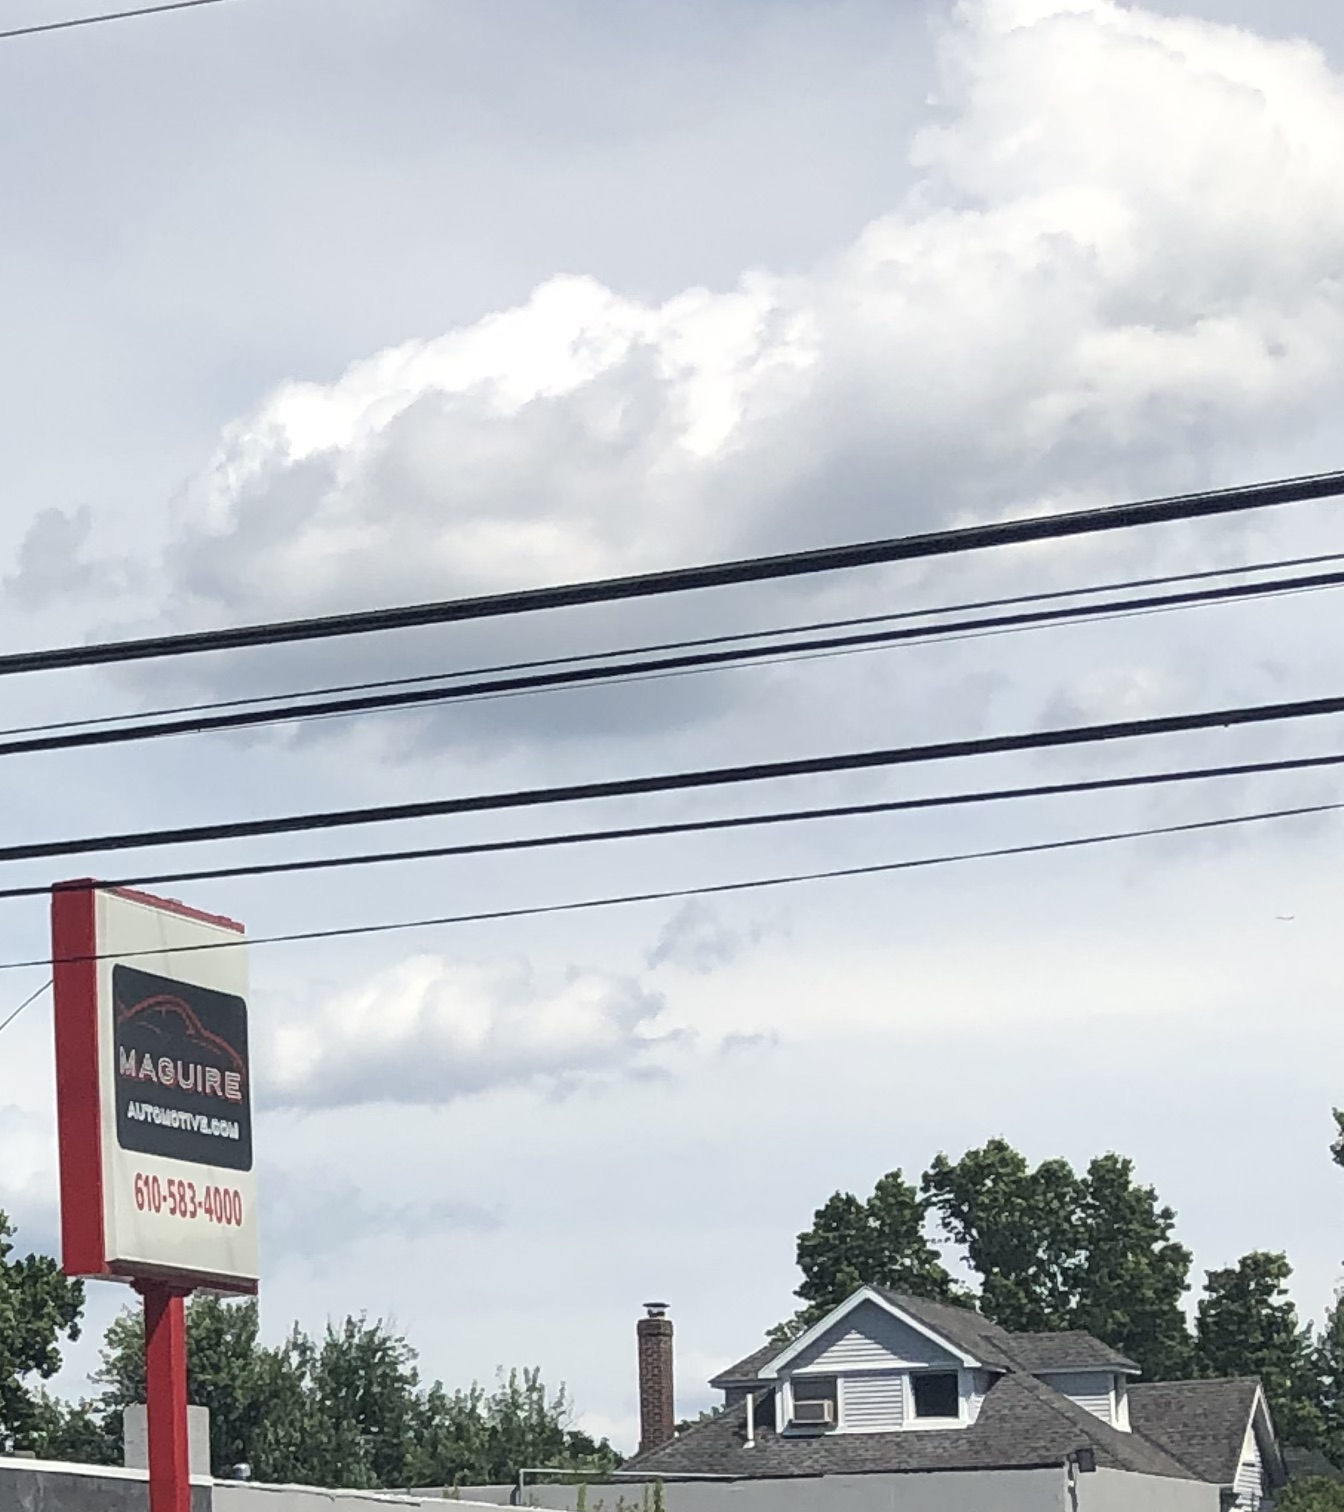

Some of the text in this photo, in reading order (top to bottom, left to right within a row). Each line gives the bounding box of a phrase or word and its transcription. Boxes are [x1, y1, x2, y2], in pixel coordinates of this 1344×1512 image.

[119, 1046, 243, 1102] MAGUIRE
[127, 1101, 240, 1140] AUTOMOTIVE.COM
[134, 1172, 243, 1227] 610-583-4000
